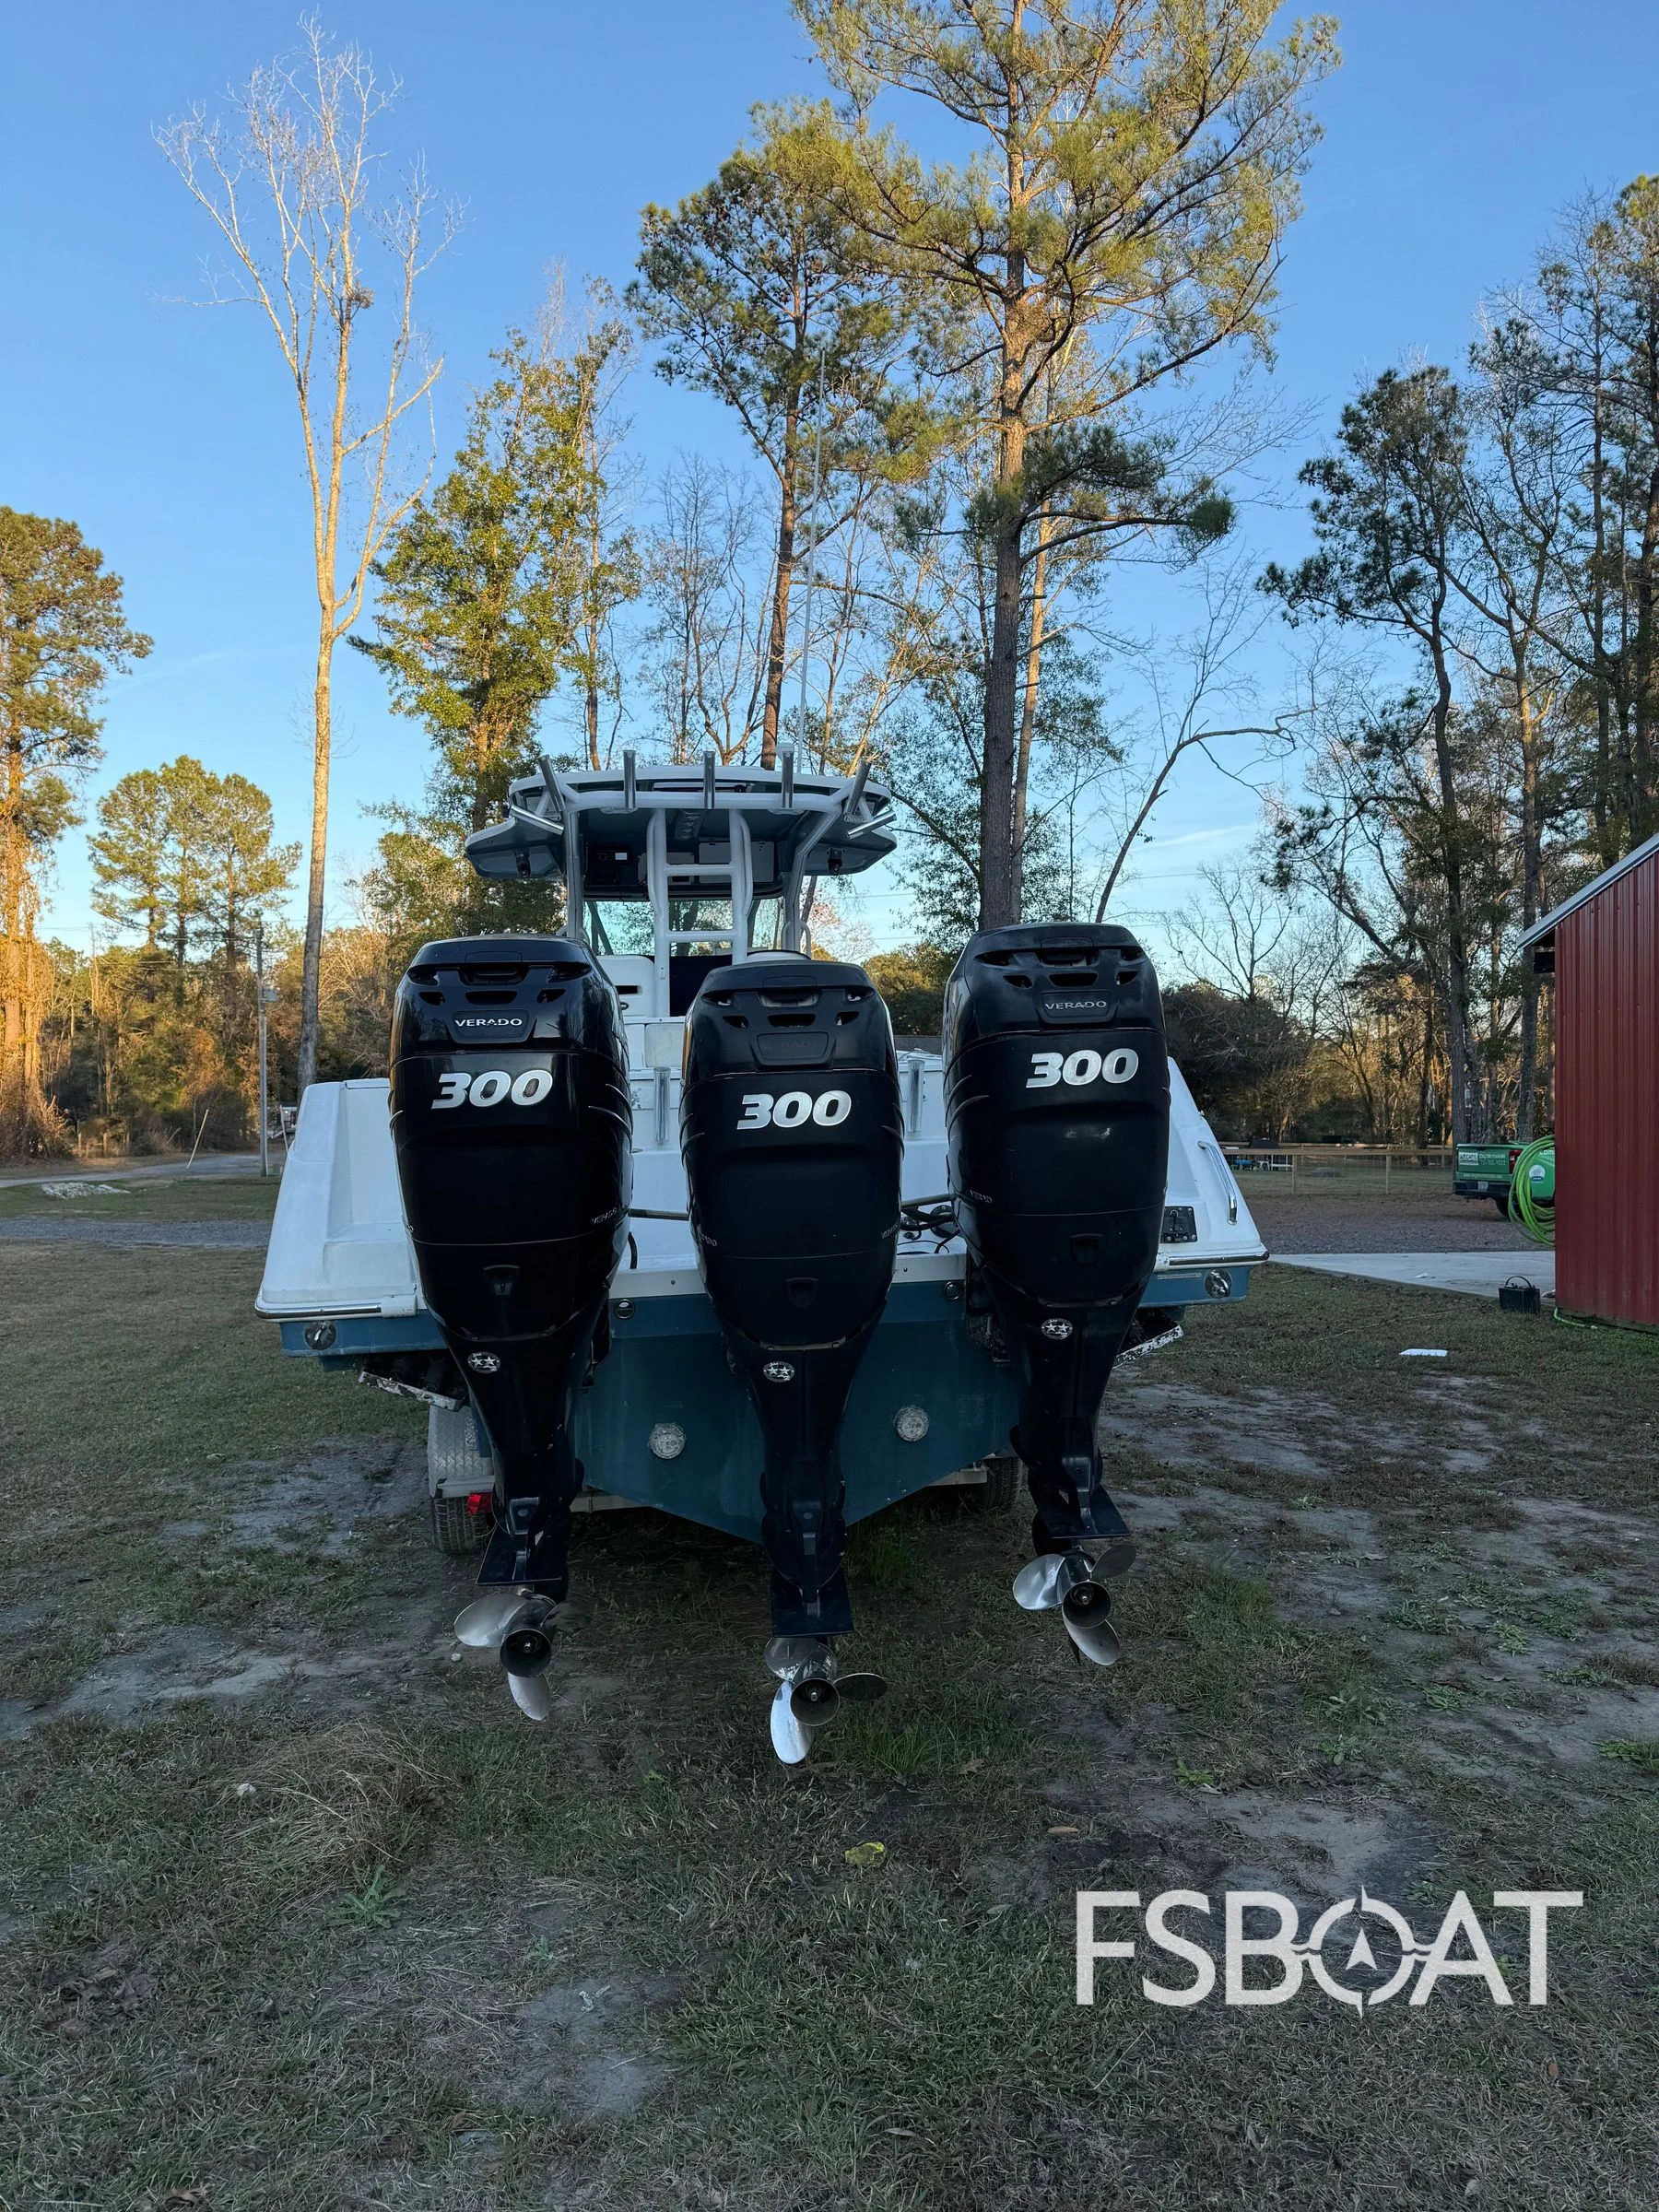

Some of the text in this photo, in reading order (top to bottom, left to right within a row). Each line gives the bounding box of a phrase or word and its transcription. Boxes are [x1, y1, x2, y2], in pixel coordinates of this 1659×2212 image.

[454, 1018, 523, 1027] VERADO
[1044, 1000, 1107, 1010] VERADO
[1026, 1048, 1139, 1088] 300
[431, 1069, 553, 1110] 300
[736, 1089, 852, 1130] 300
